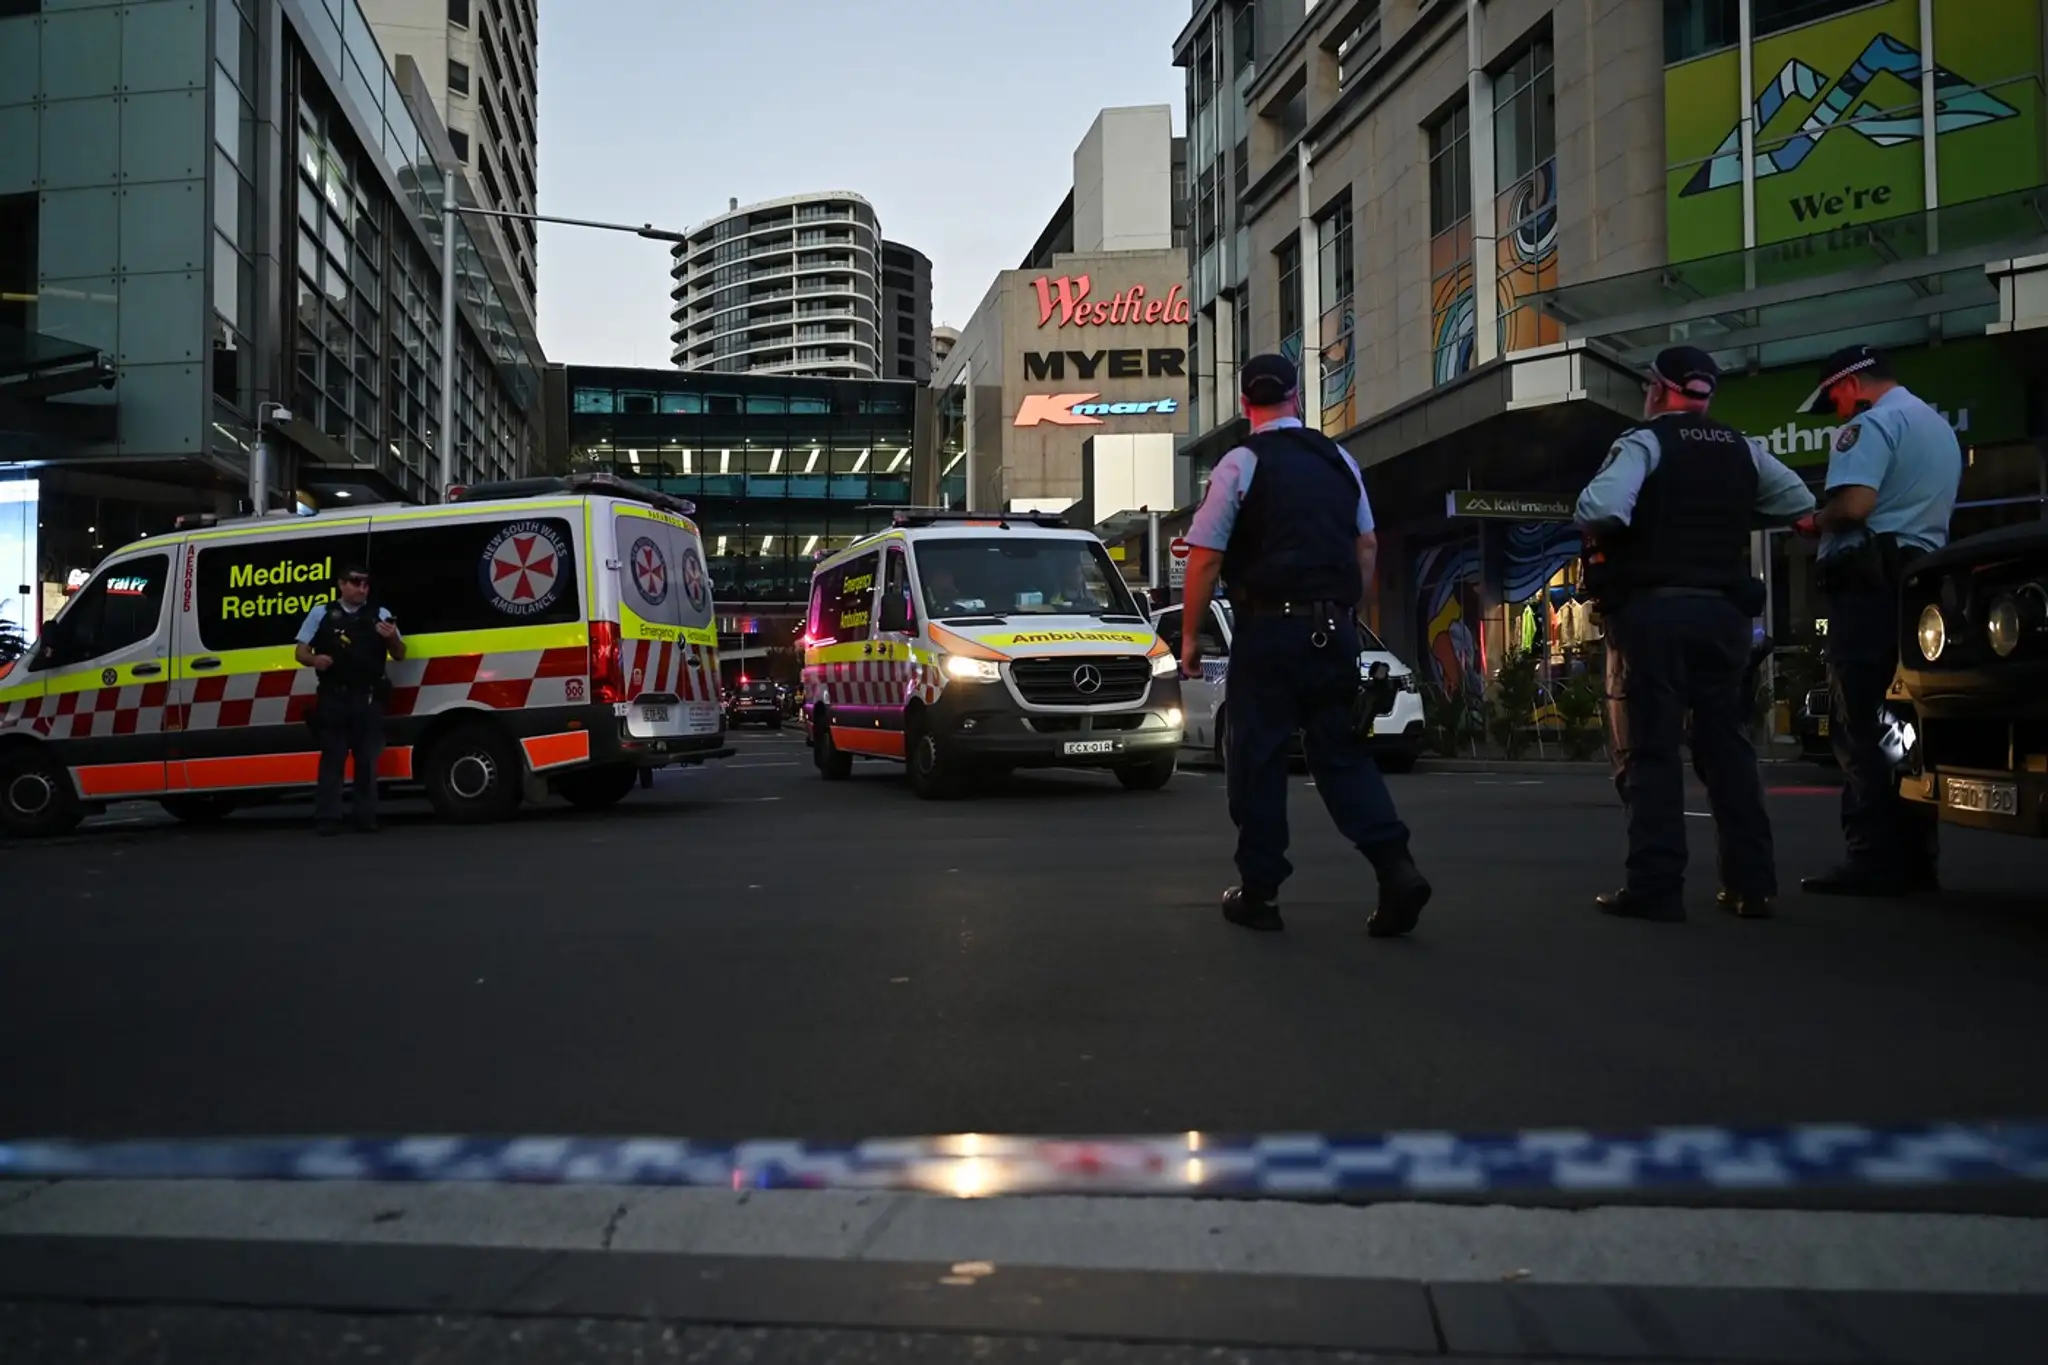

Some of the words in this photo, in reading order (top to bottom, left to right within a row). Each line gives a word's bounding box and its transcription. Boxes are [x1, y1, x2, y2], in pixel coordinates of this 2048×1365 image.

[1790, 185, 1892, 222] We're
[1024, 348, 1186, 381] MYER
[1013, 392, 1179, 426] Kmart
[1680, 428, 1735, 443] POLICE
[1494, 499, 1570, 513] Kathmandu
[482, 534, 503, 561] NEW
[502, 521, 540, 538] SOUTH
[541, 524, 568, 558] WALES
[229, 555, 332, 589] Medical
[221, 586, 337, 620] Retrieval
[491, 592, 556, 615] AMBULANCE
[1013, 631, 1134, 643] Ambulance
